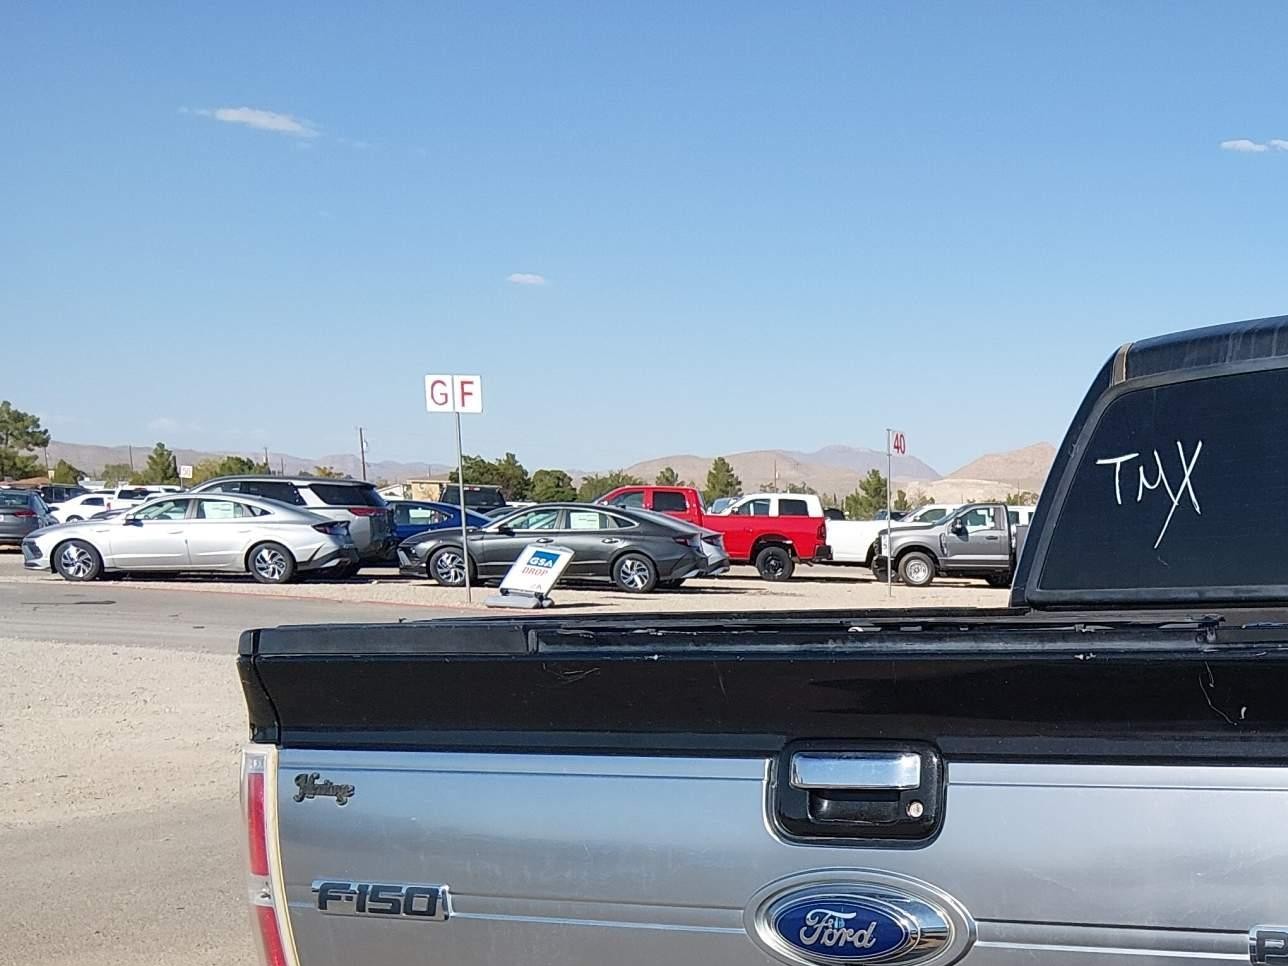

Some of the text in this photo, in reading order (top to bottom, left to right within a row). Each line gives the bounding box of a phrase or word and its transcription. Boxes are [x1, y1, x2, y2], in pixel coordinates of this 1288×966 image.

[430, 380, 474, 407] G F
[893, 433, 906, 455] 40
[529, 556, 554, 568] GSA
[318, 882, 440, 917] F-150
[799, 908, 877, 949] Ford
